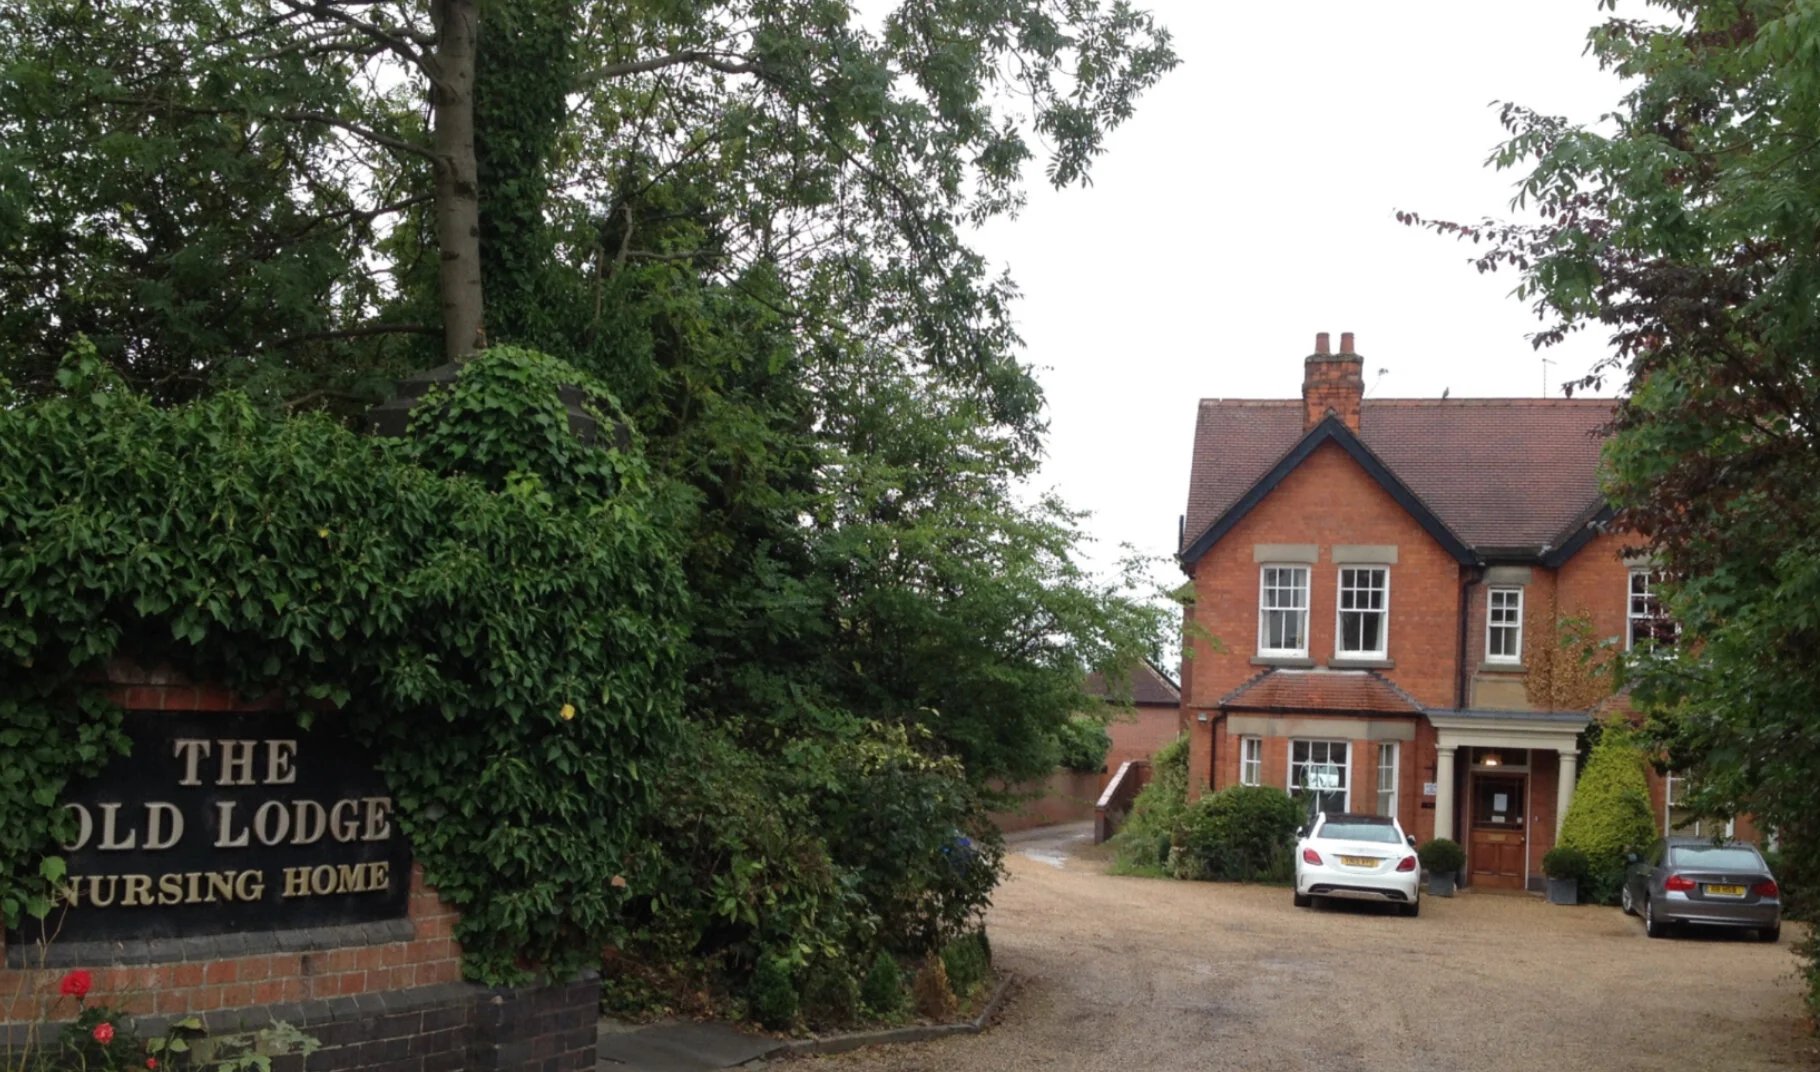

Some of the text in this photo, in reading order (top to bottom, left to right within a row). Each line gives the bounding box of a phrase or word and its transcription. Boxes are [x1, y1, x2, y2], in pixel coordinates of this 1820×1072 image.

[174, 738, 297, 786] THE
[62, 797, 393, 851] OLD LODGE
[50, 860, 390, 908] NURSING HOME
